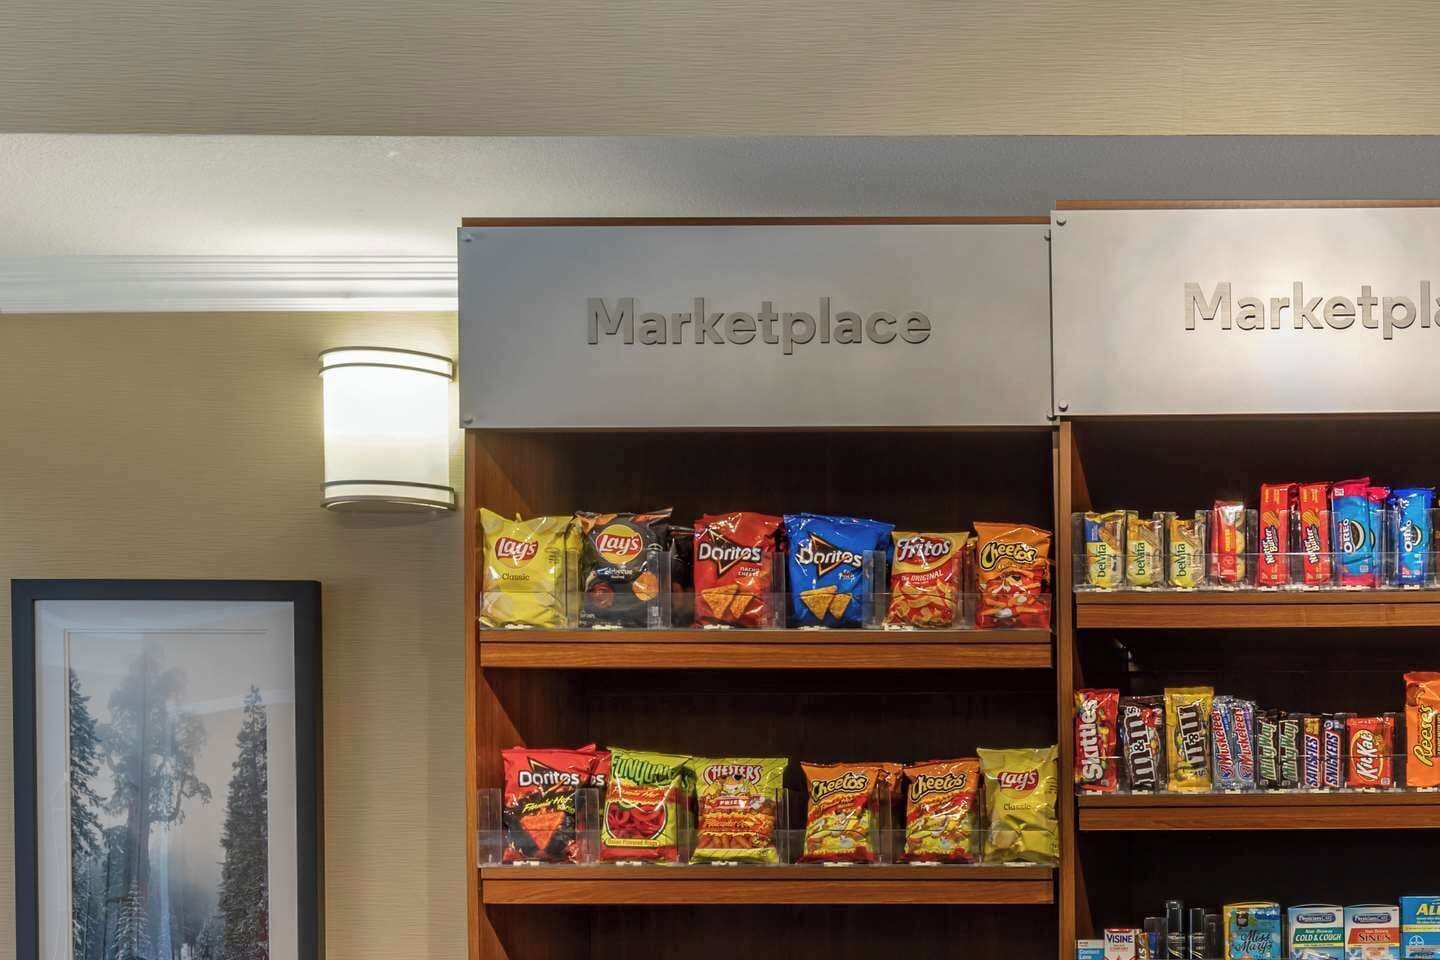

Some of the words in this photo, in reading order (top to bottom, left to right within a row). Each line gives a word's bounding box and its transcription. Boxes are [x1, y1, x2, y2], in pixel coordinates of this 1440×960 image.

[586, 296, 931, 355] Marketplace
[600, 535, 640, 556] Lay's
[1343, 518, 1353, 553] OREO
[698, 543, 761, 562] Doritos
[799, 541, 863, 567] Doritos
[896, 538, 951, 562] Fritos
[980, 542, 1038, 570] Cheetos
[1082, 699, 1103, 780] Skittles
[1413, 704, 1433, 767] Reese's
[1325, 731, 1339, 786] SNICKERS
[519, 771, 580, 787] Doritos
[811, 773, 869, 802] Cheetos
[912, 773, 966, 801] Cheetos
[999, 770, 1037, 791] Lay's
[1106, 934, 1133, 943] VISINE
[1241, 930, 1271, 942] Miss
[1295, 934, 1314, 942] COLD
